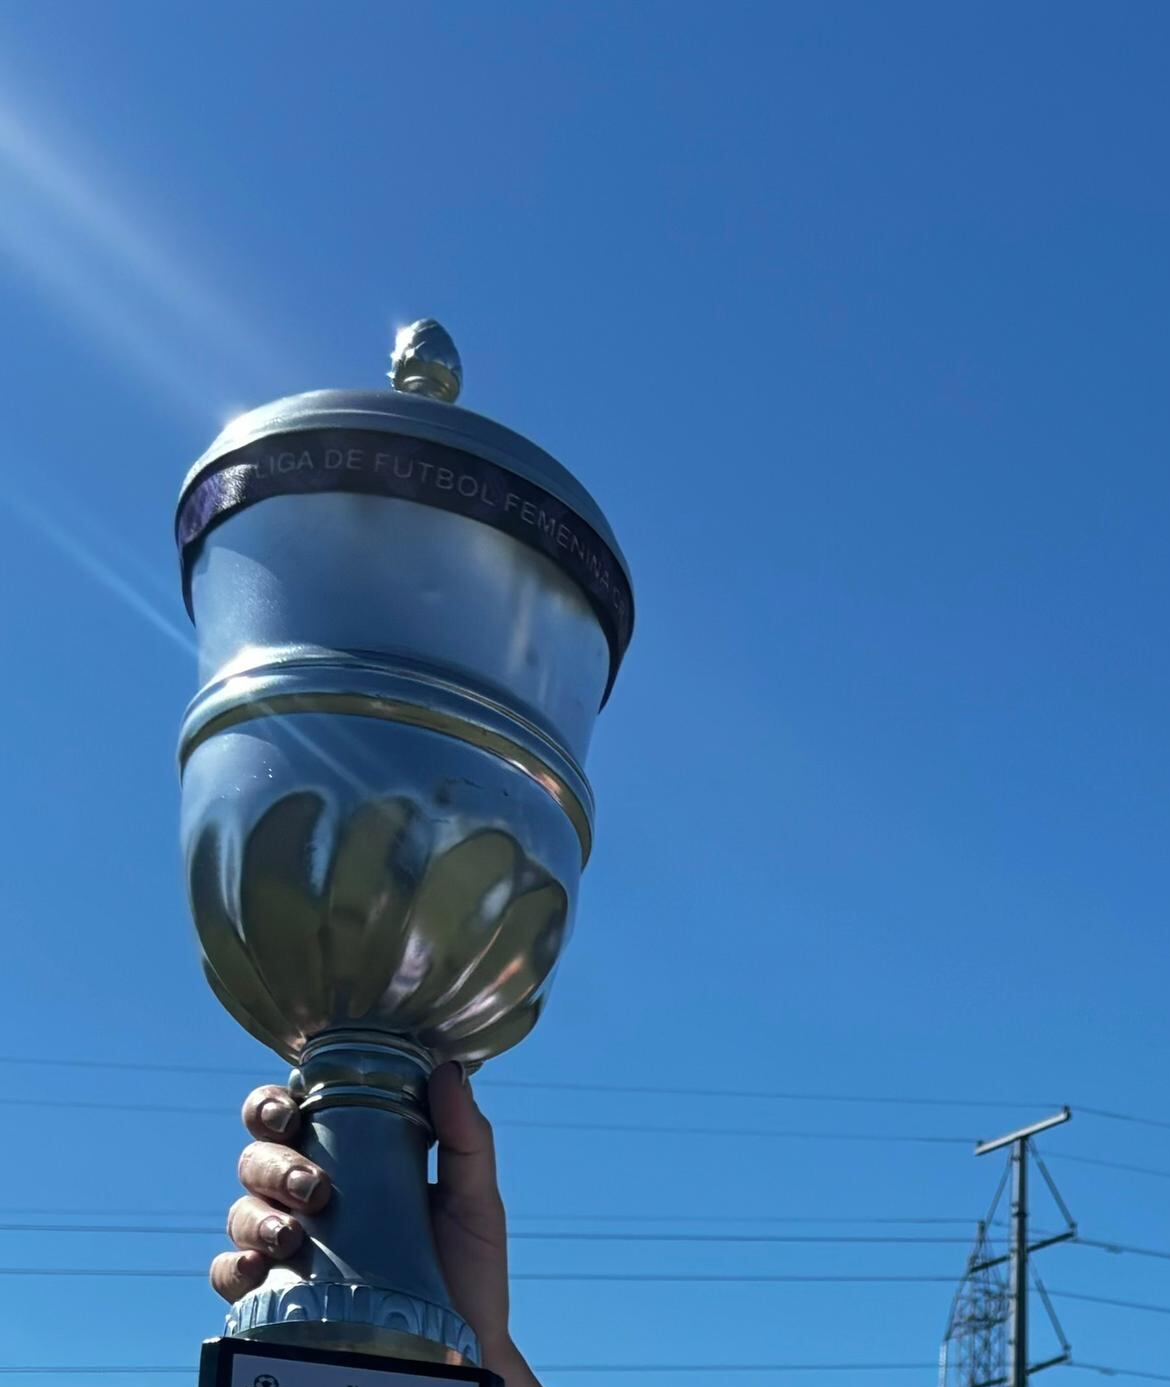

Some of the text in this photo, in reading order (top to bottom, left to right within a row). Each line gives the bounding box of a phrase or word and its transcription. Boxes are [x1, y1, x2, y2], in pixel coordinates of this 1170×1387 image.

[255, 450, 314, 479] LIGA
[325, 449, 364, 470] DE
[374, 452, 495, 506] FUTBOL
[504, 493, 609, 589] FEMENINA
